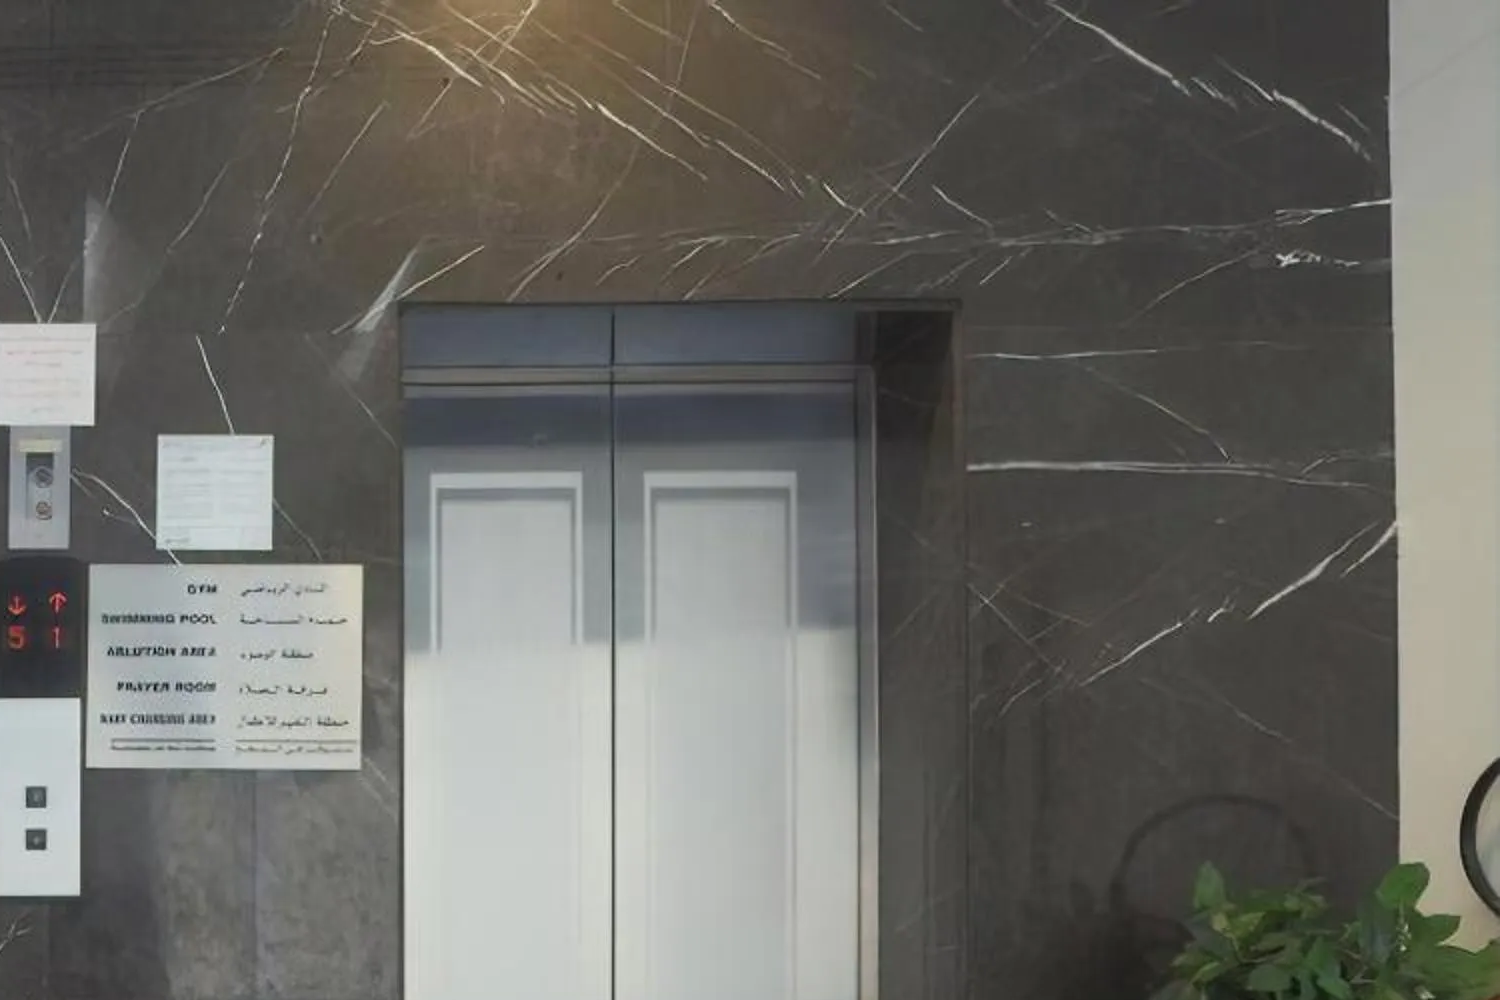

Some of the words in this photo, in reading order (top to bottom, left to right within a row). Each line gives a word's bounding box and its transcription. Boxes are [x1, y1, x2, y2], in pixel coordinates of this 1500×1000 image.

[187, 583, 218, 595] GYM
[101, 613, 176, 624] SWIMMING
[179, 613, 218, 624] POOL
[7, 626, 26, 650] 5
[107, 645, 177, 657] ABLUTION
[180, 645, 217, 657] AREA
[116, 681, 170, 693] PRAYER
[175, 681, 217, 693] ROOM
